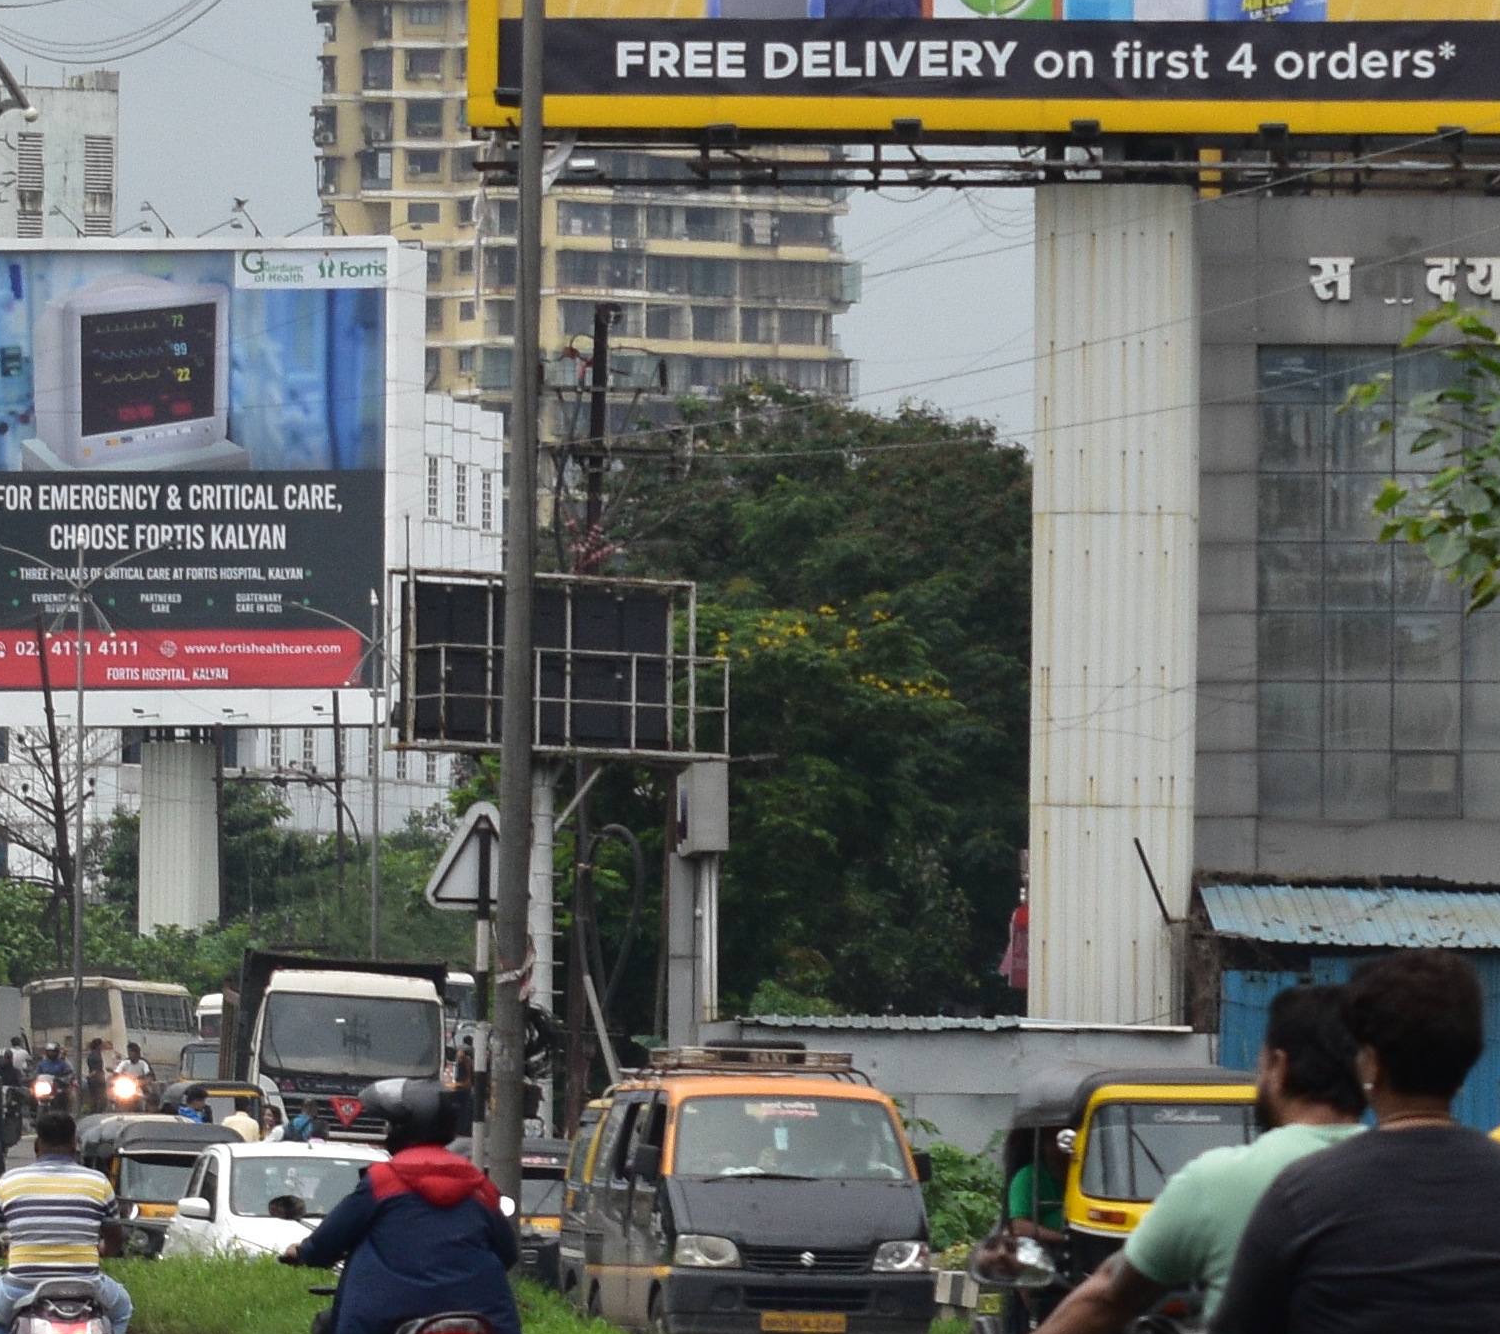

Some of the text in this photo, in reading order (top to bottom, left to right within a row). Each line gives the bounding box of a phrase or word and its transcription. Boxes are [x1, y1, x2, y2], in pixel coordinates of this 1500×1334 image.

[615, 39, 752, 81] FREE
[762, 37, 1017, 81] DELIVERY
[1036, 45, 1095, 81] on
[1111, 38, 1210, 81] first
[1225, 43, 1259, 79] 4
[269, 272, 304, 283] Health
[341, 260, 387, 278] Fortis
[176, 367, 191, 382] 22
[38, 485, 160, 511] EMERGENCY
[166, 485, 184, 511] &
[188, 485, 280, 511] CRITICAL
[283, 484, 344, 514] CARE,
[50, 524, 287, 551] CHOOSE FORTIS KALYAN
[20, 567, 48, 580] THREE
[104, 567, 145, 580] CRITICAL
[147, 567, 171, 581] CARE
[172, 567, 185, 581] AT
[186, 567, 218, 581] FORTIS
[220, 567, 267, 582] HOSPITAL,
[268, 567, 304, 581] KALYAN
[98, 641, 139, 657] 4111
[184, 640, 342, 657] www.fortishealthcare.com
[106, 667, 229, 682] FORTIS HOSPITAL, KALYAN
